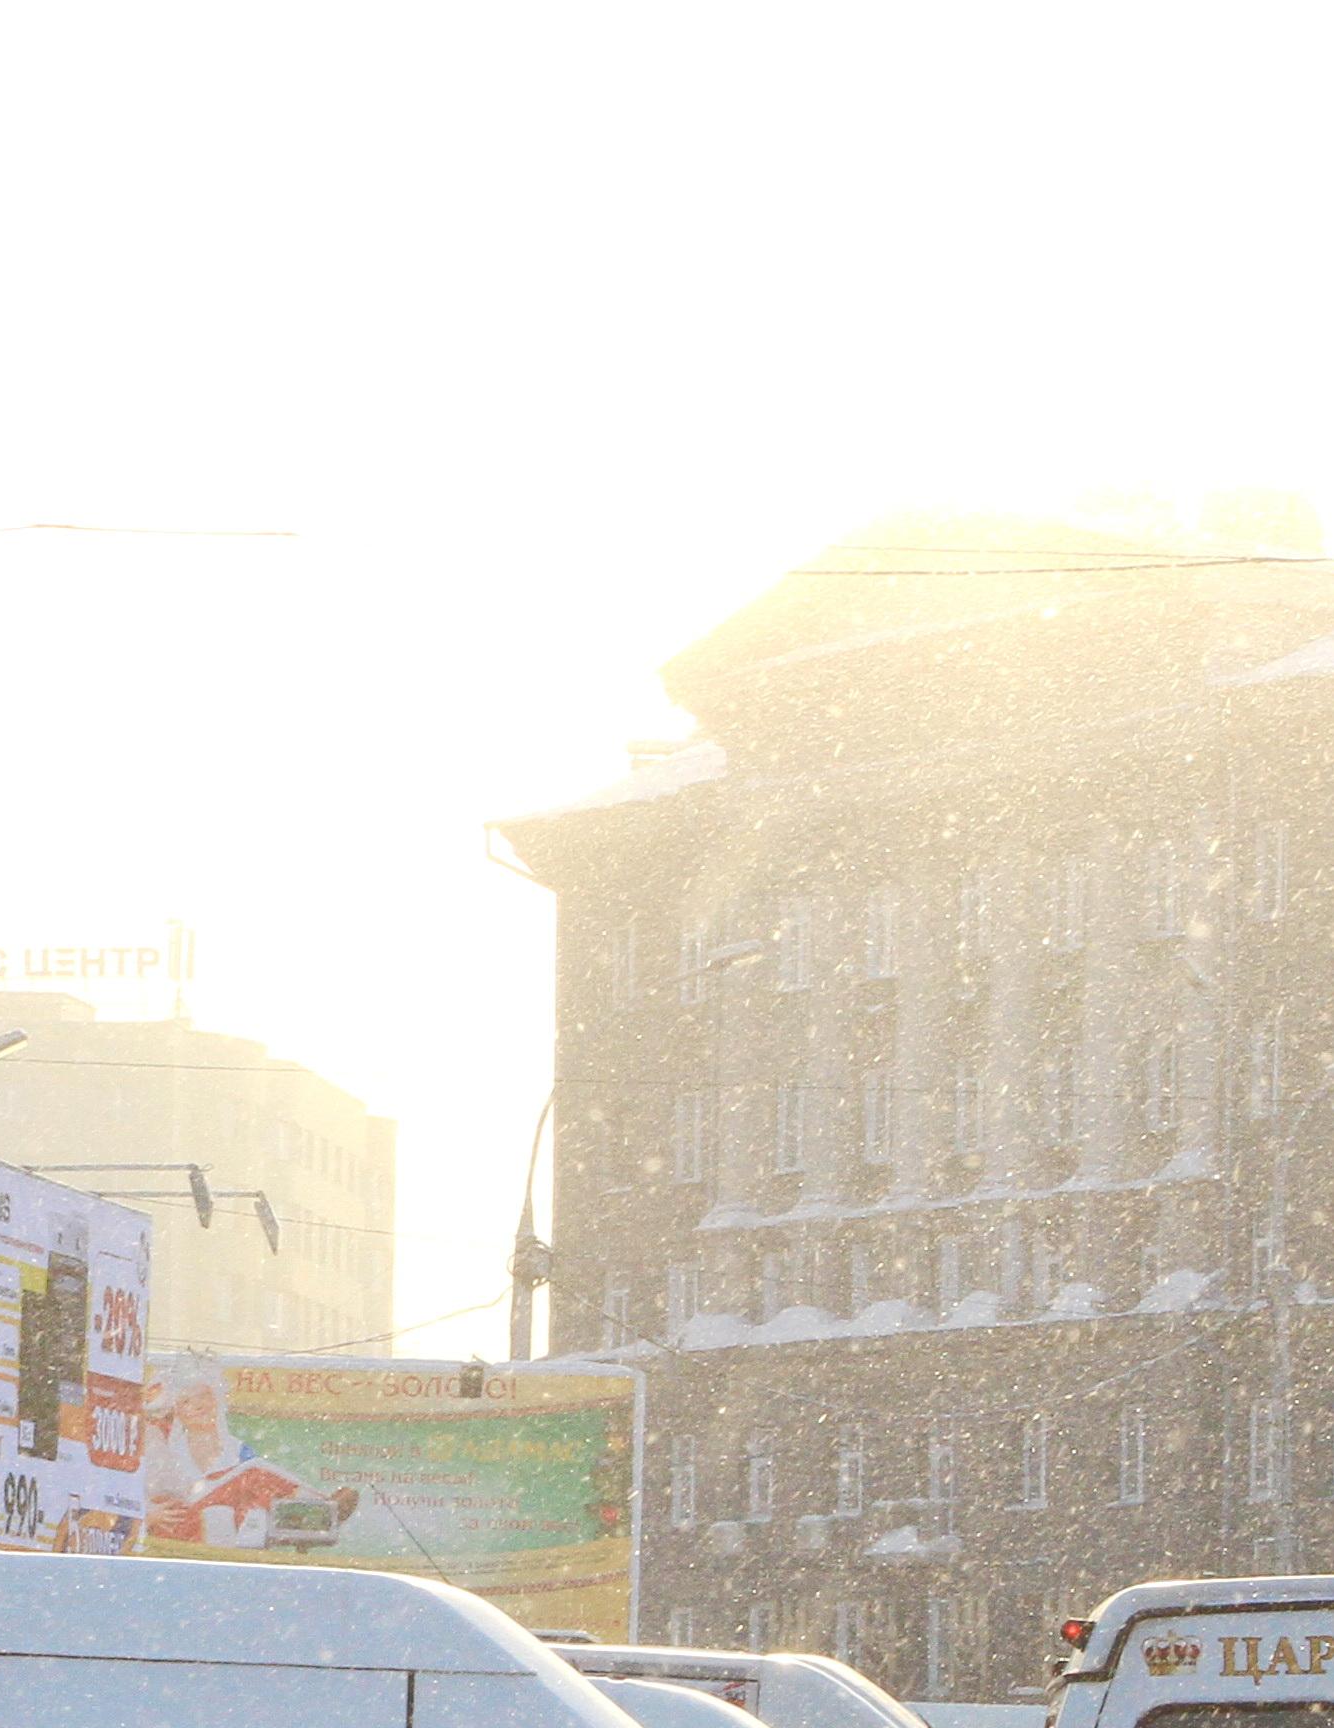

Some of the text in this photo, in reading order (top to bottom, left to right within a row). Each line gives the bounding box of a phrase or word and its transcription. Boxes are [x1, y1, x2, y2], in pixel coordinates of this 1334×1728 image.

[24, 947, 161, 978] ЦЕНТР
[236, 1371, 517, 1399] НА ВЕС ЗОЛОО!
